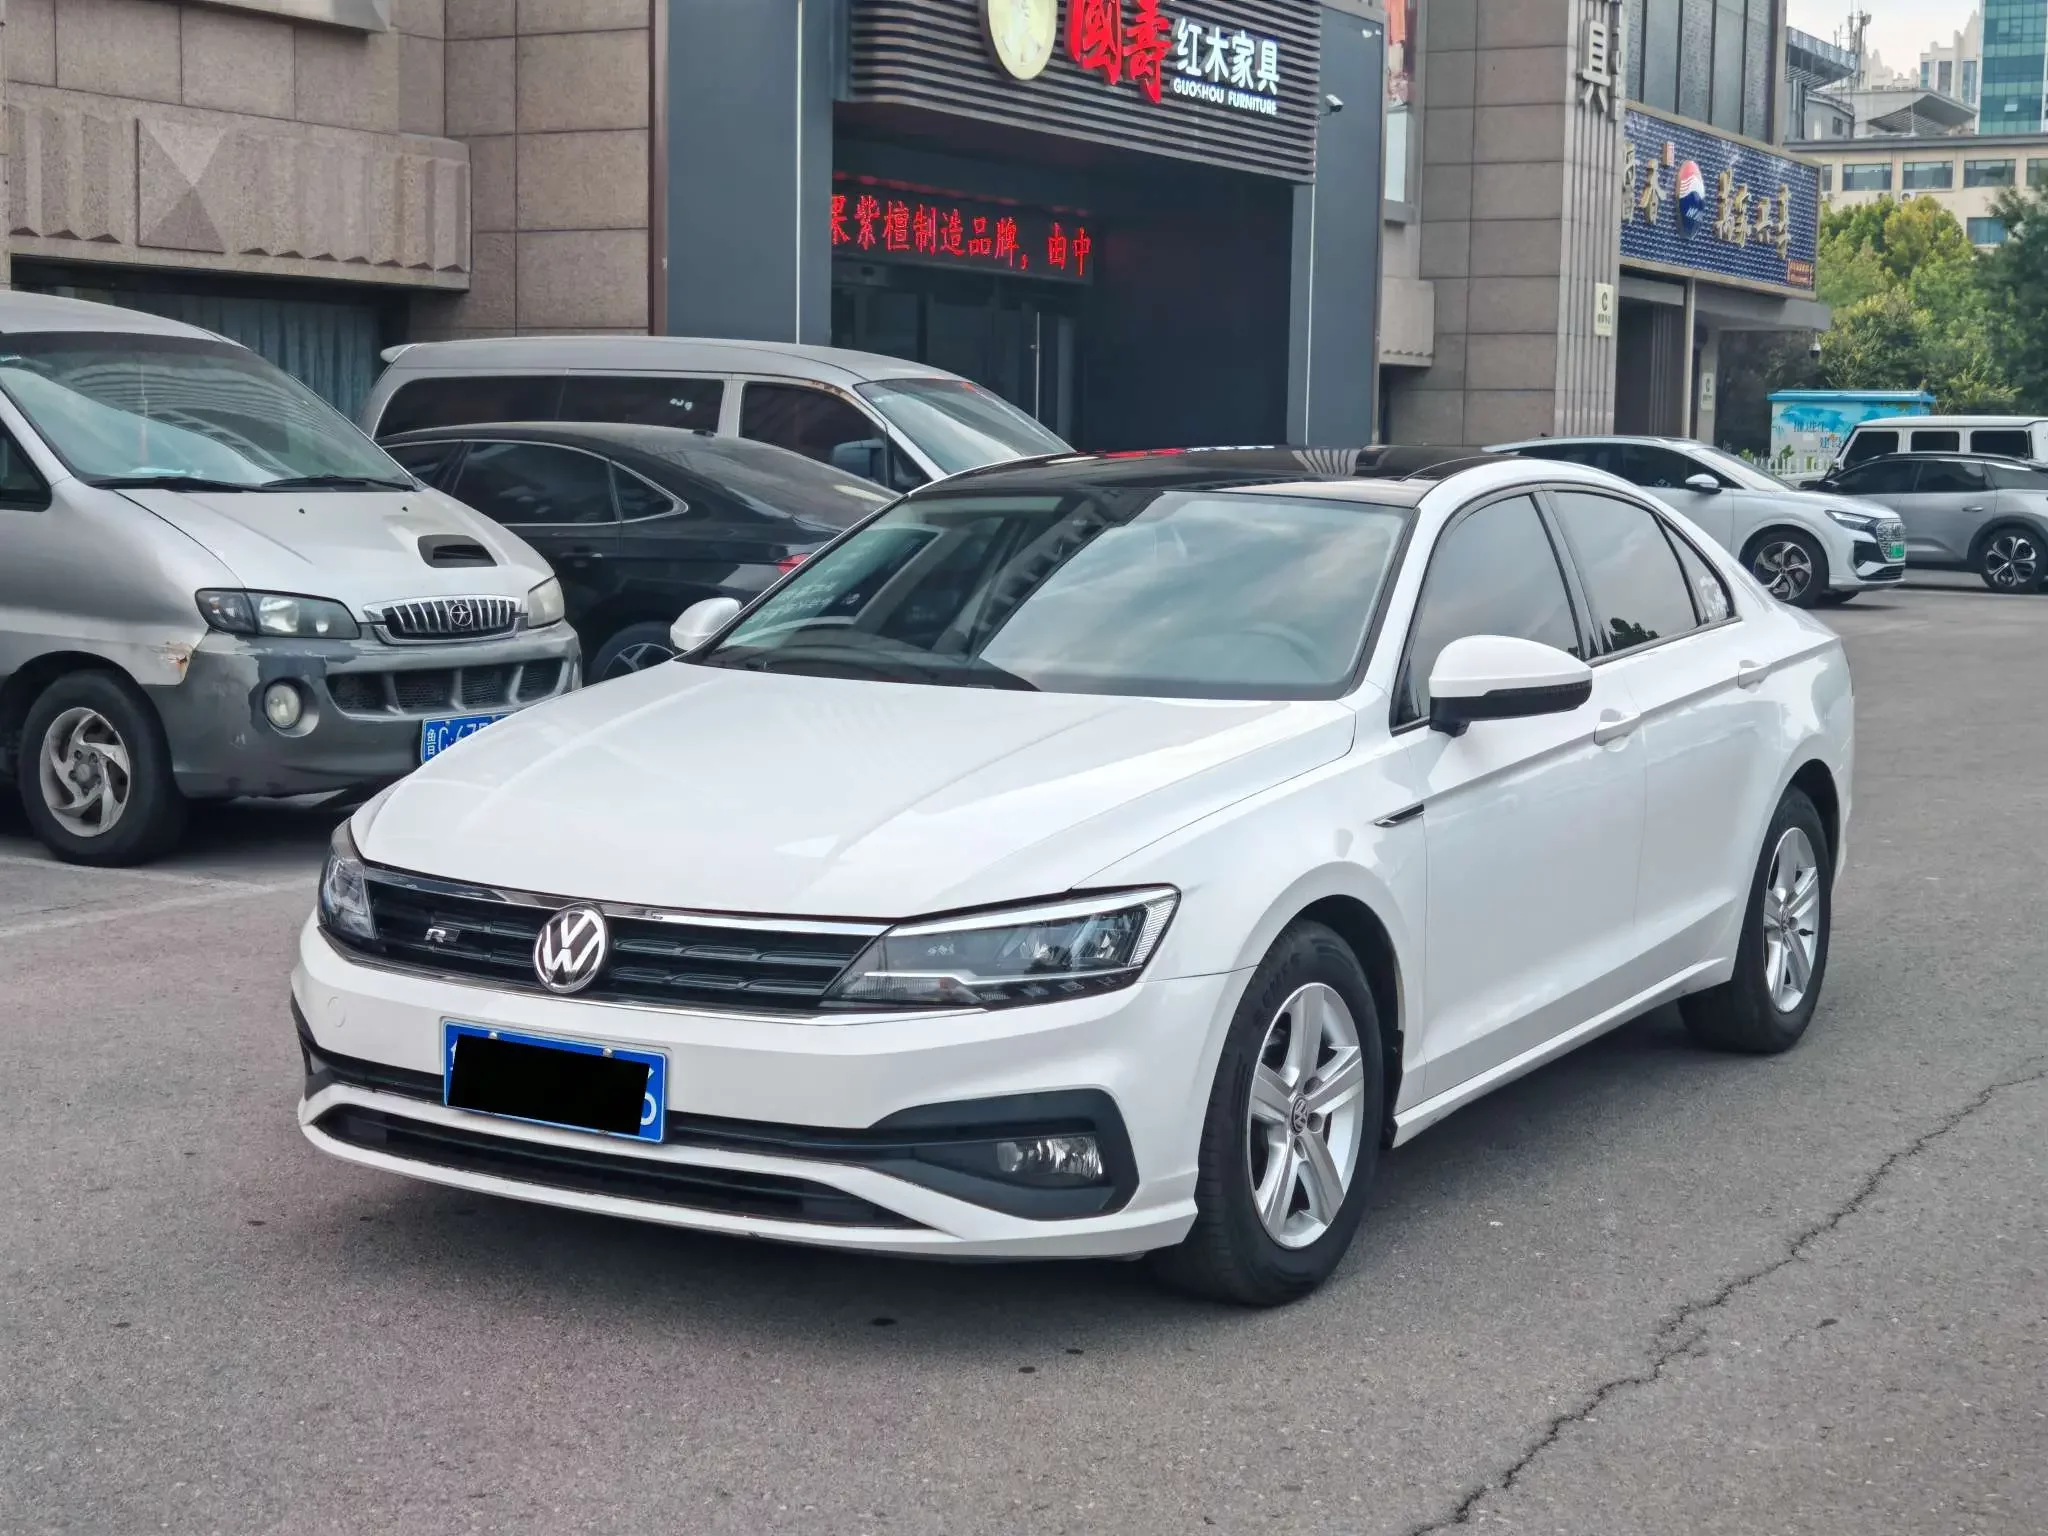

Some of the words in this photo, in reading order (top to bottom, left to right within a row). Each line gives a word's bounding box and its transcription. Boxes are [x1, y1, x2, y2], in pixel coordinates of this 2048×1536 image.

[1176, 17, 1280, 95] 红木家具
[1173, 77, 1225, 103] GUOSHOU
[1228, 90, 1278, 115] FURNITURE
